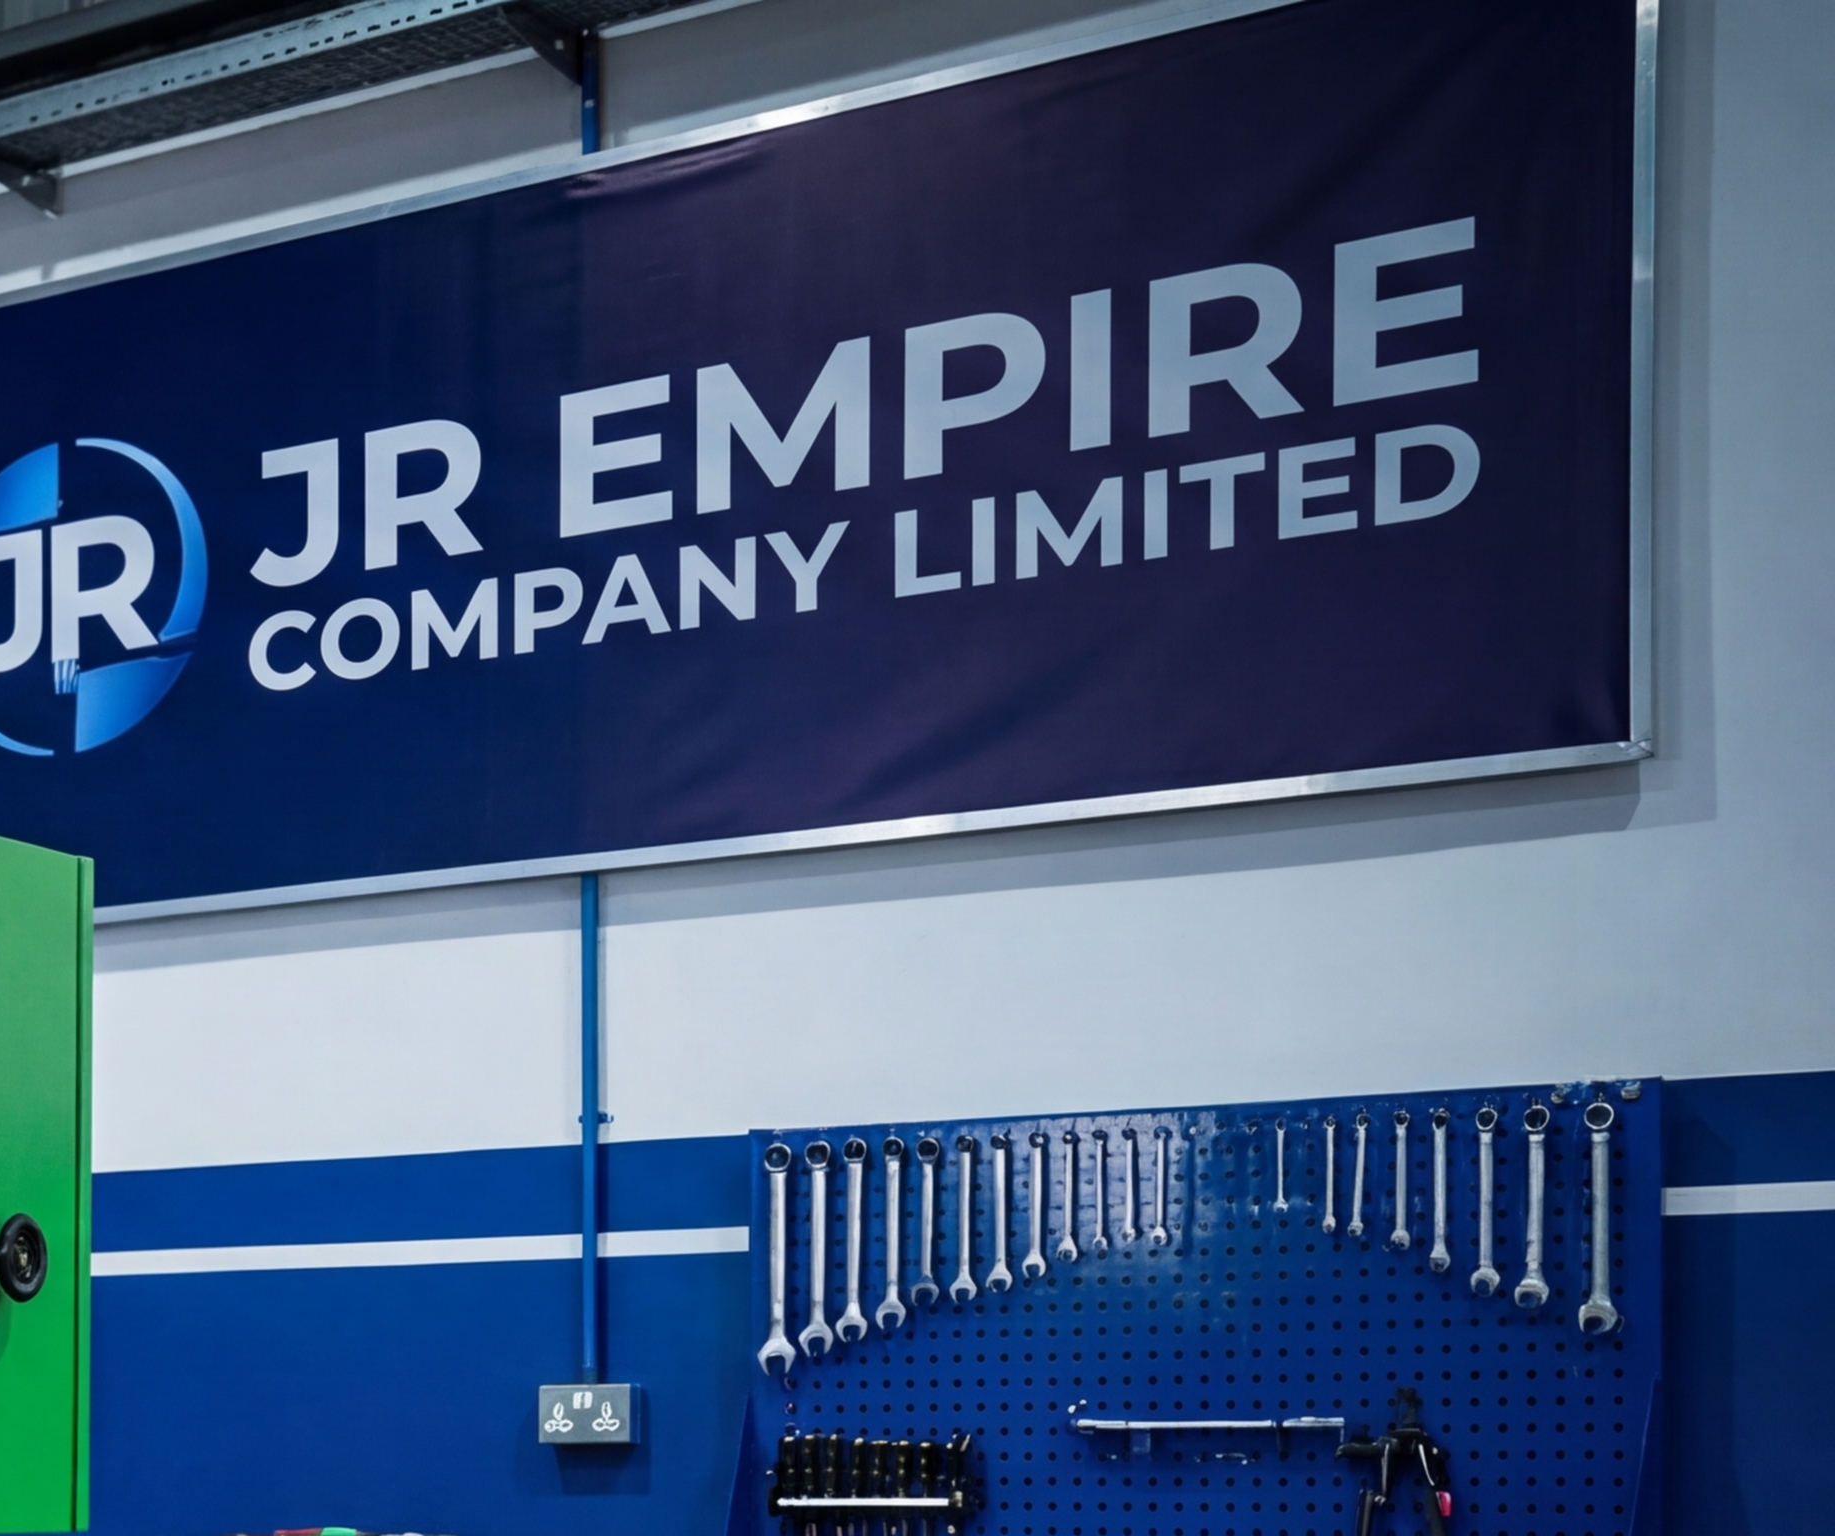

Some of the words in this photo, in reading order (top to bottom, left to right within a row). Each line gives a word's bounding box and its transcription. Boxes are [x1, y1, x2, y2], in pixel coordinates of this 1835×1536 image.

[248, 521, 849, 691] COMPANY
[895, 424, 1480, 599] LIMITED
[249, 420, 483, 588] JR
[560, 217, 1479, 541] EMPIRE
